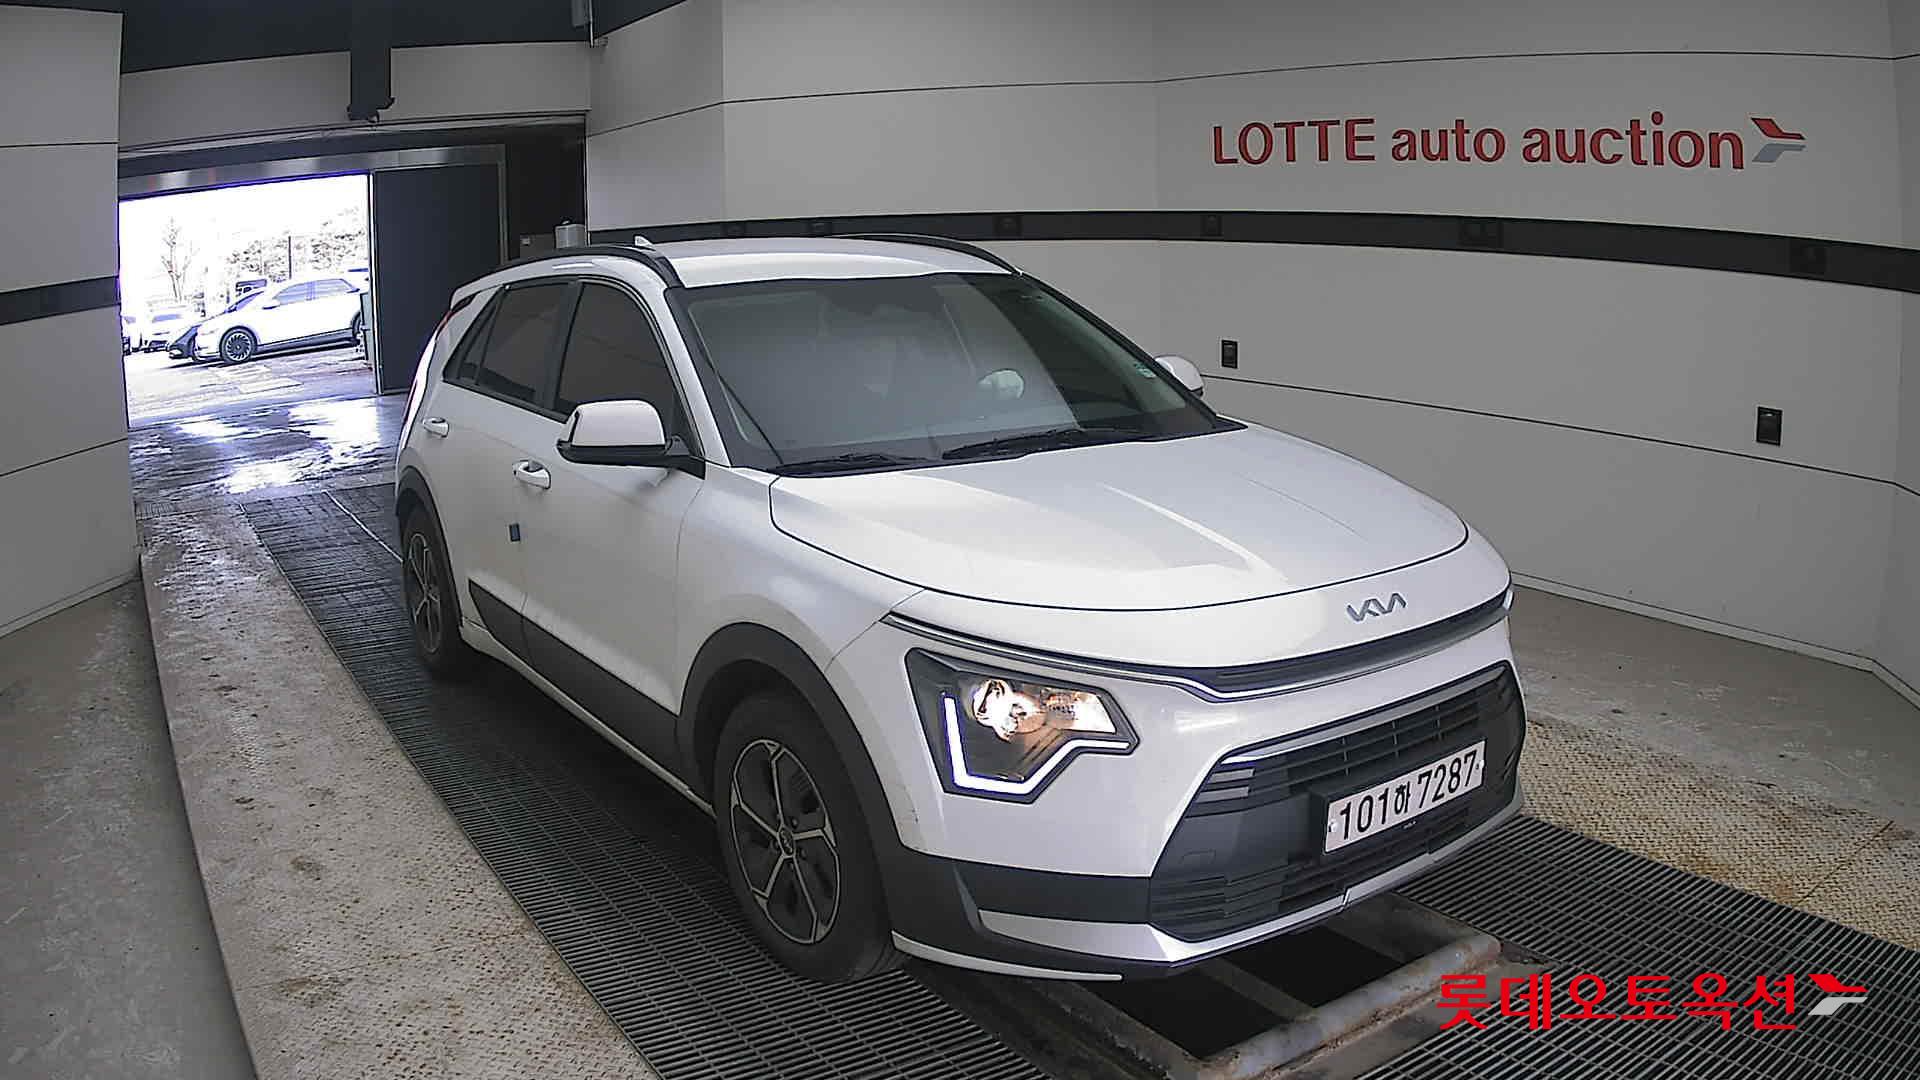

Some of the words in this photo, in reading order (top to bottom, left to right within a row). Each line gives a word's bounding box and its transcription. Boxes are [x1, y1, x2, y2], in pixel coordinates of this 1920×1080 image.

[1213, 118, 1375, 165] LOTTE
[1391, 119, 1506, 163] auto
[1522, 111, 1744, 170] auction
[1417, 749, 1478, 809] 7287
